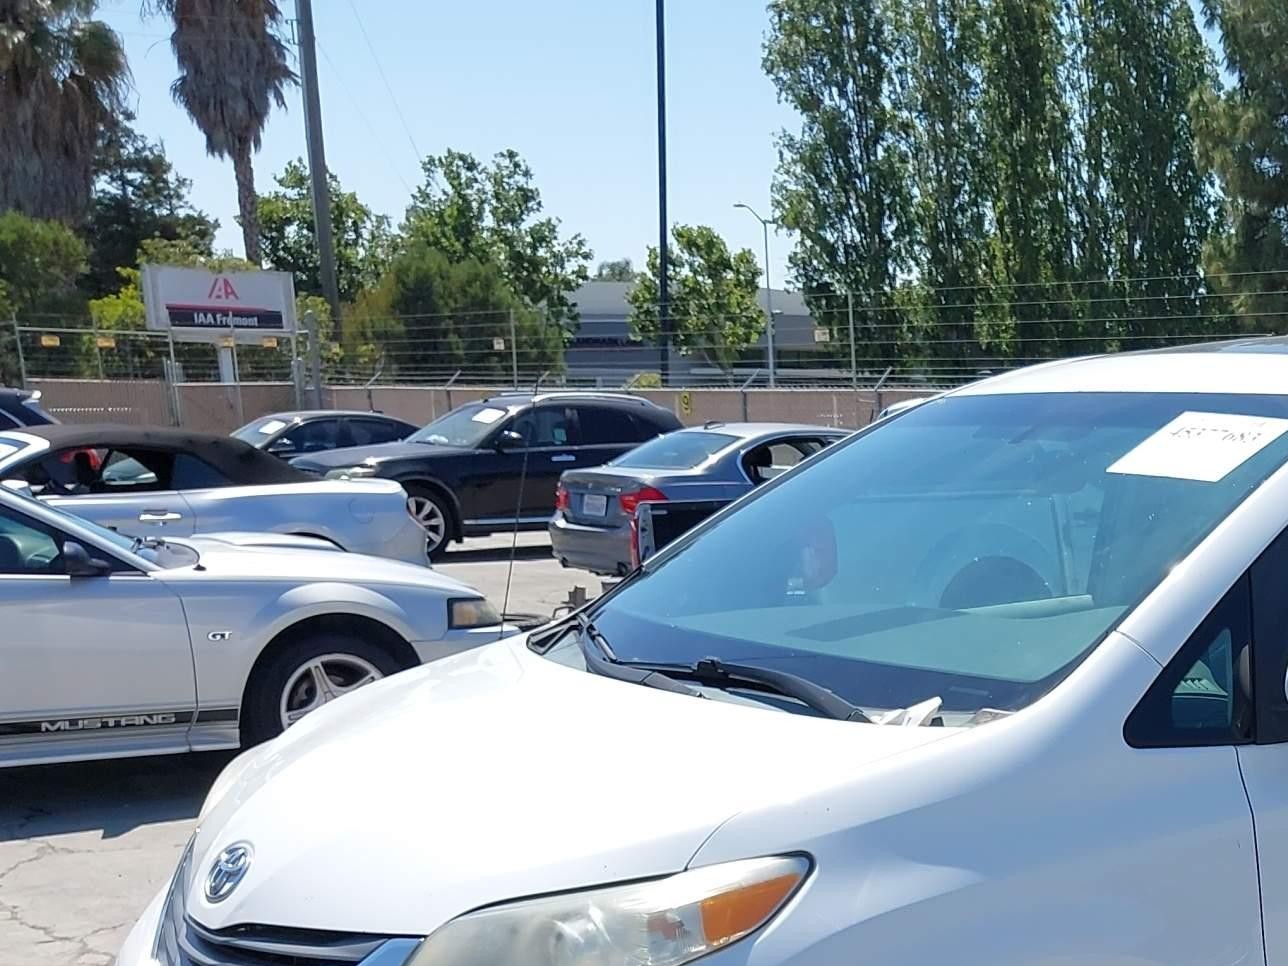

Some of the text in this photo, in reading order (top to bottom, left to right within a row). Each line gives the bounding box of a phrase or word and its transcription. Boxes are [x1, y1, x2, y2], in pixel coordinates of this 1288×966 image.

[193, 312, 215, 324] IAA
[207, 631, 233, 641] GT
[40, 713, 176, 732] MUSTANG
